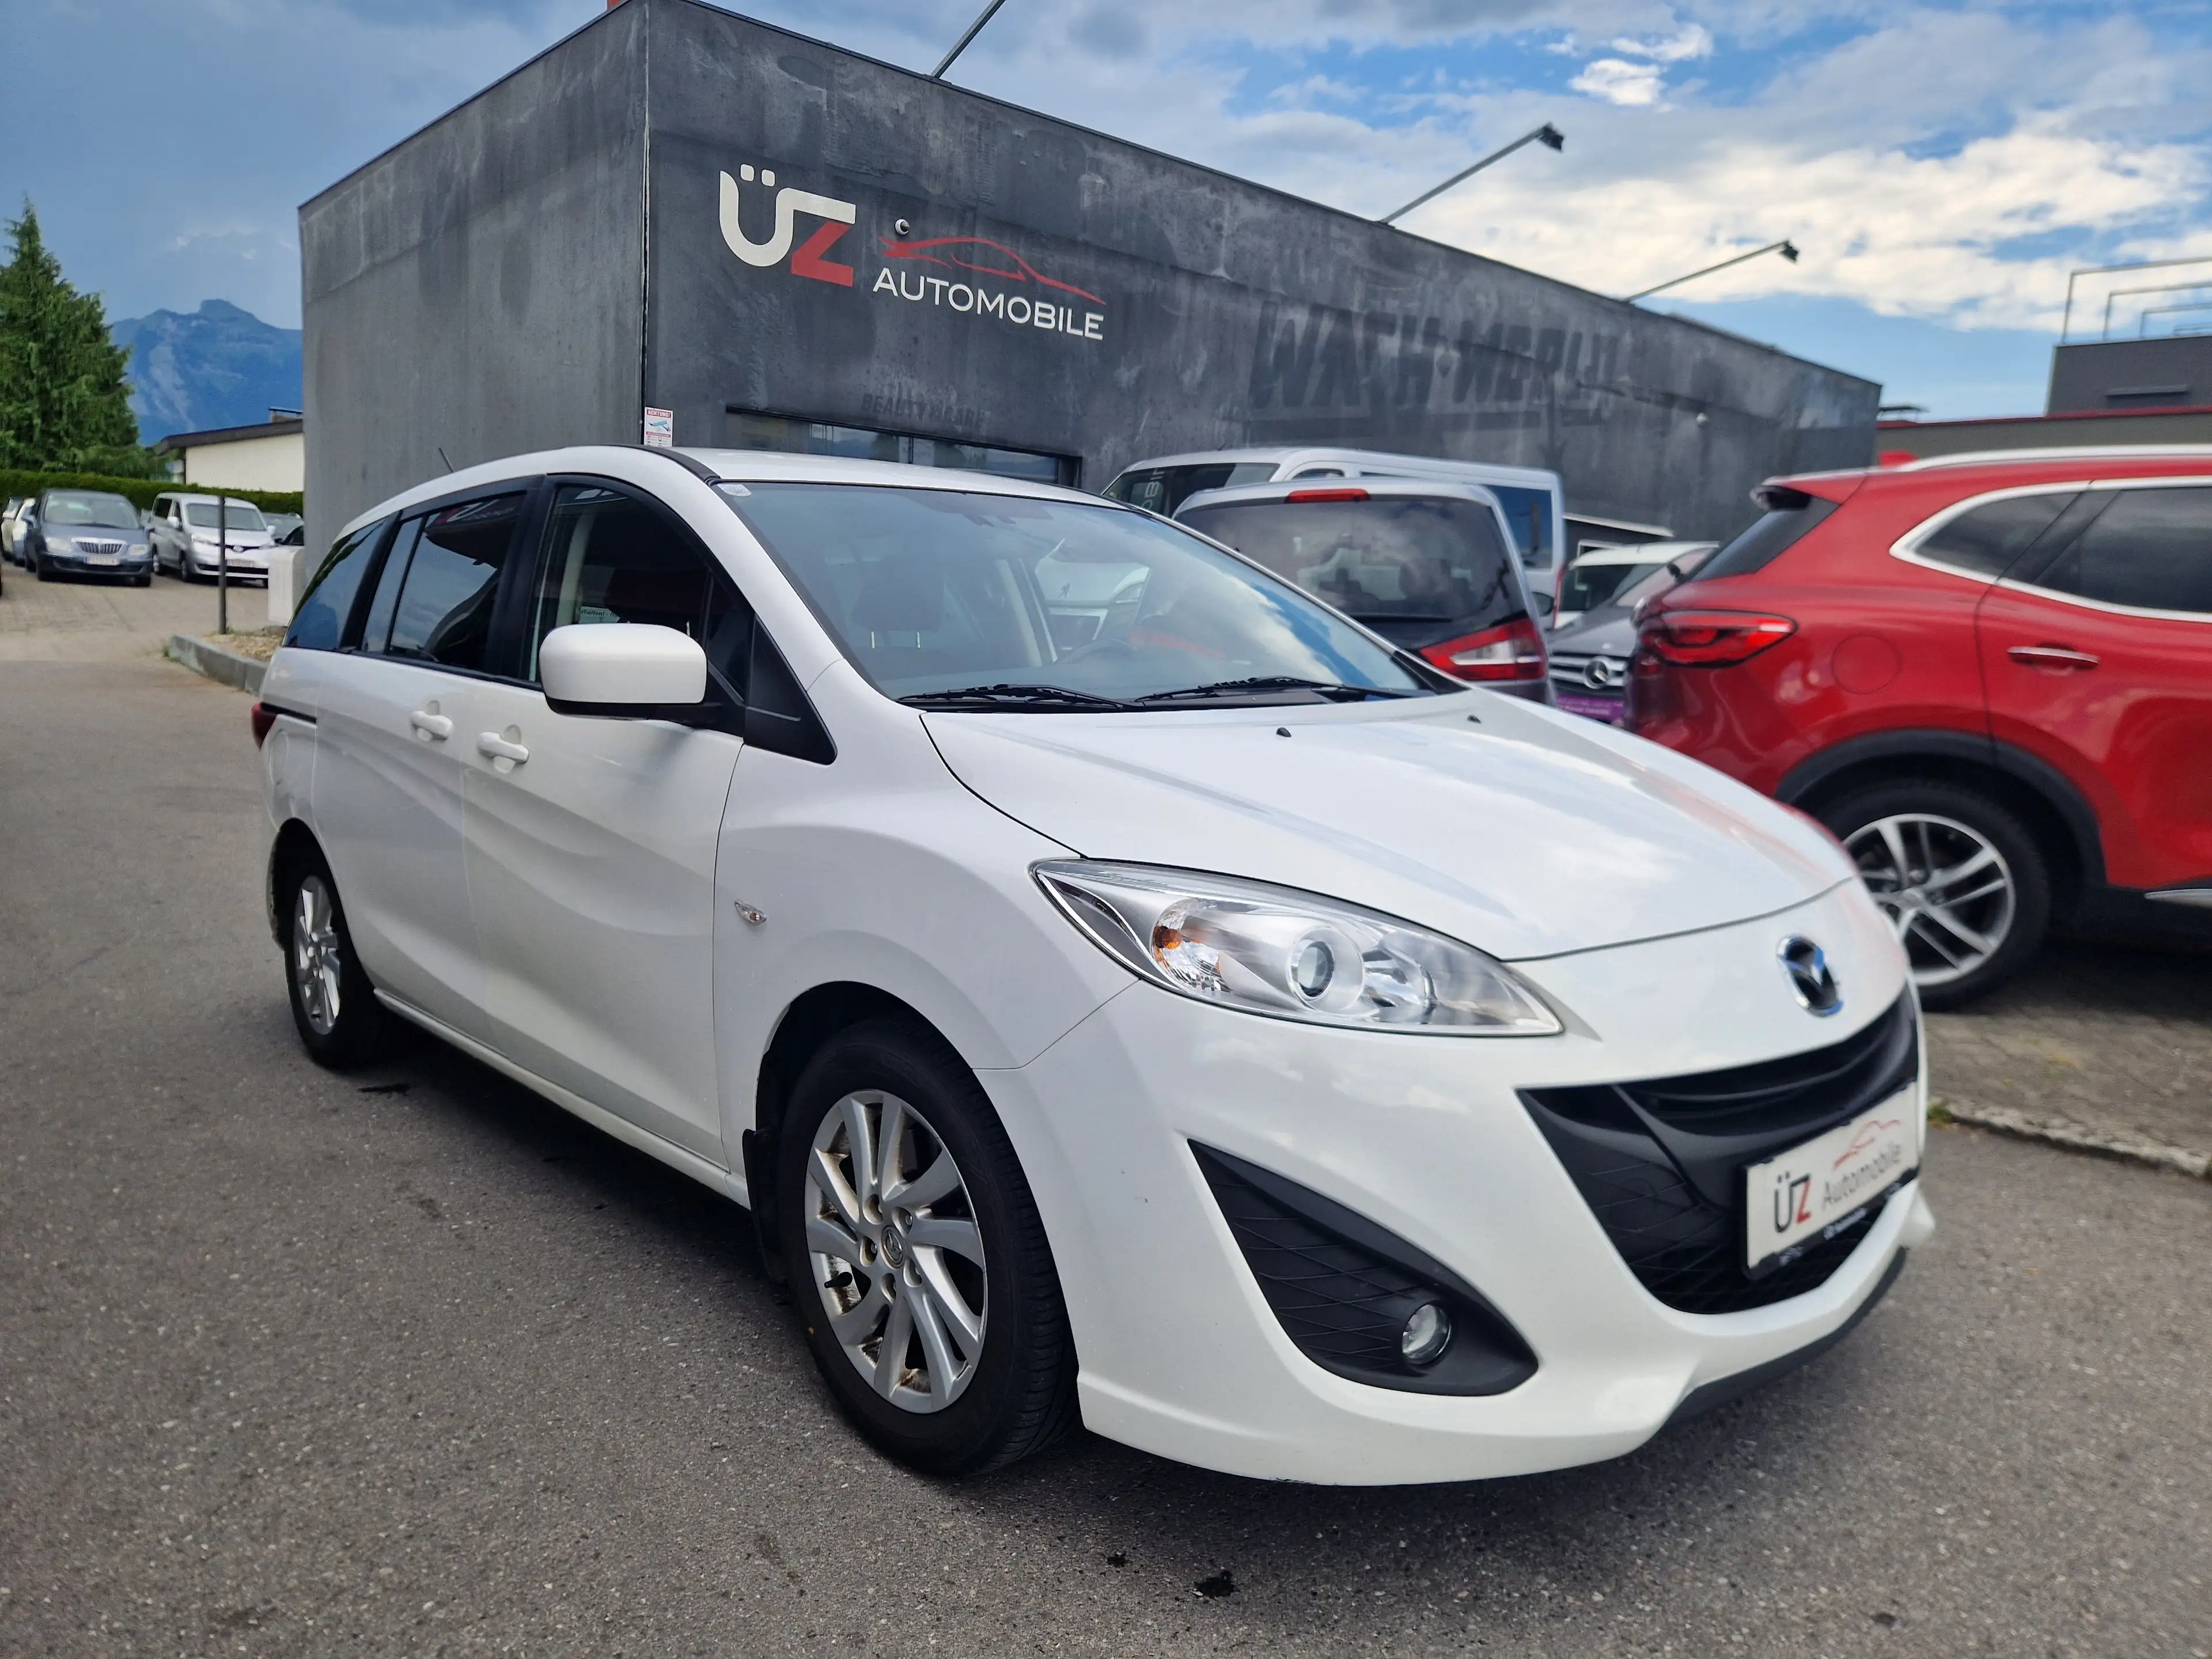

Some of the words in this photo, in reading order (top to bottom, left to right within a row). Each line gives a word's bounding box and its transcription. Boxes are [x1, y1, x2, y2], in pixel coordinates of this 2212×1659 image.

[719, 164, 856, 287] ÜZ
[873, 268, 1105, 340] AUTOMOBILE
[647, 409, 671, 418] ACHTUNG!
[1775, 1171, 1811, 1233] ÜZ
